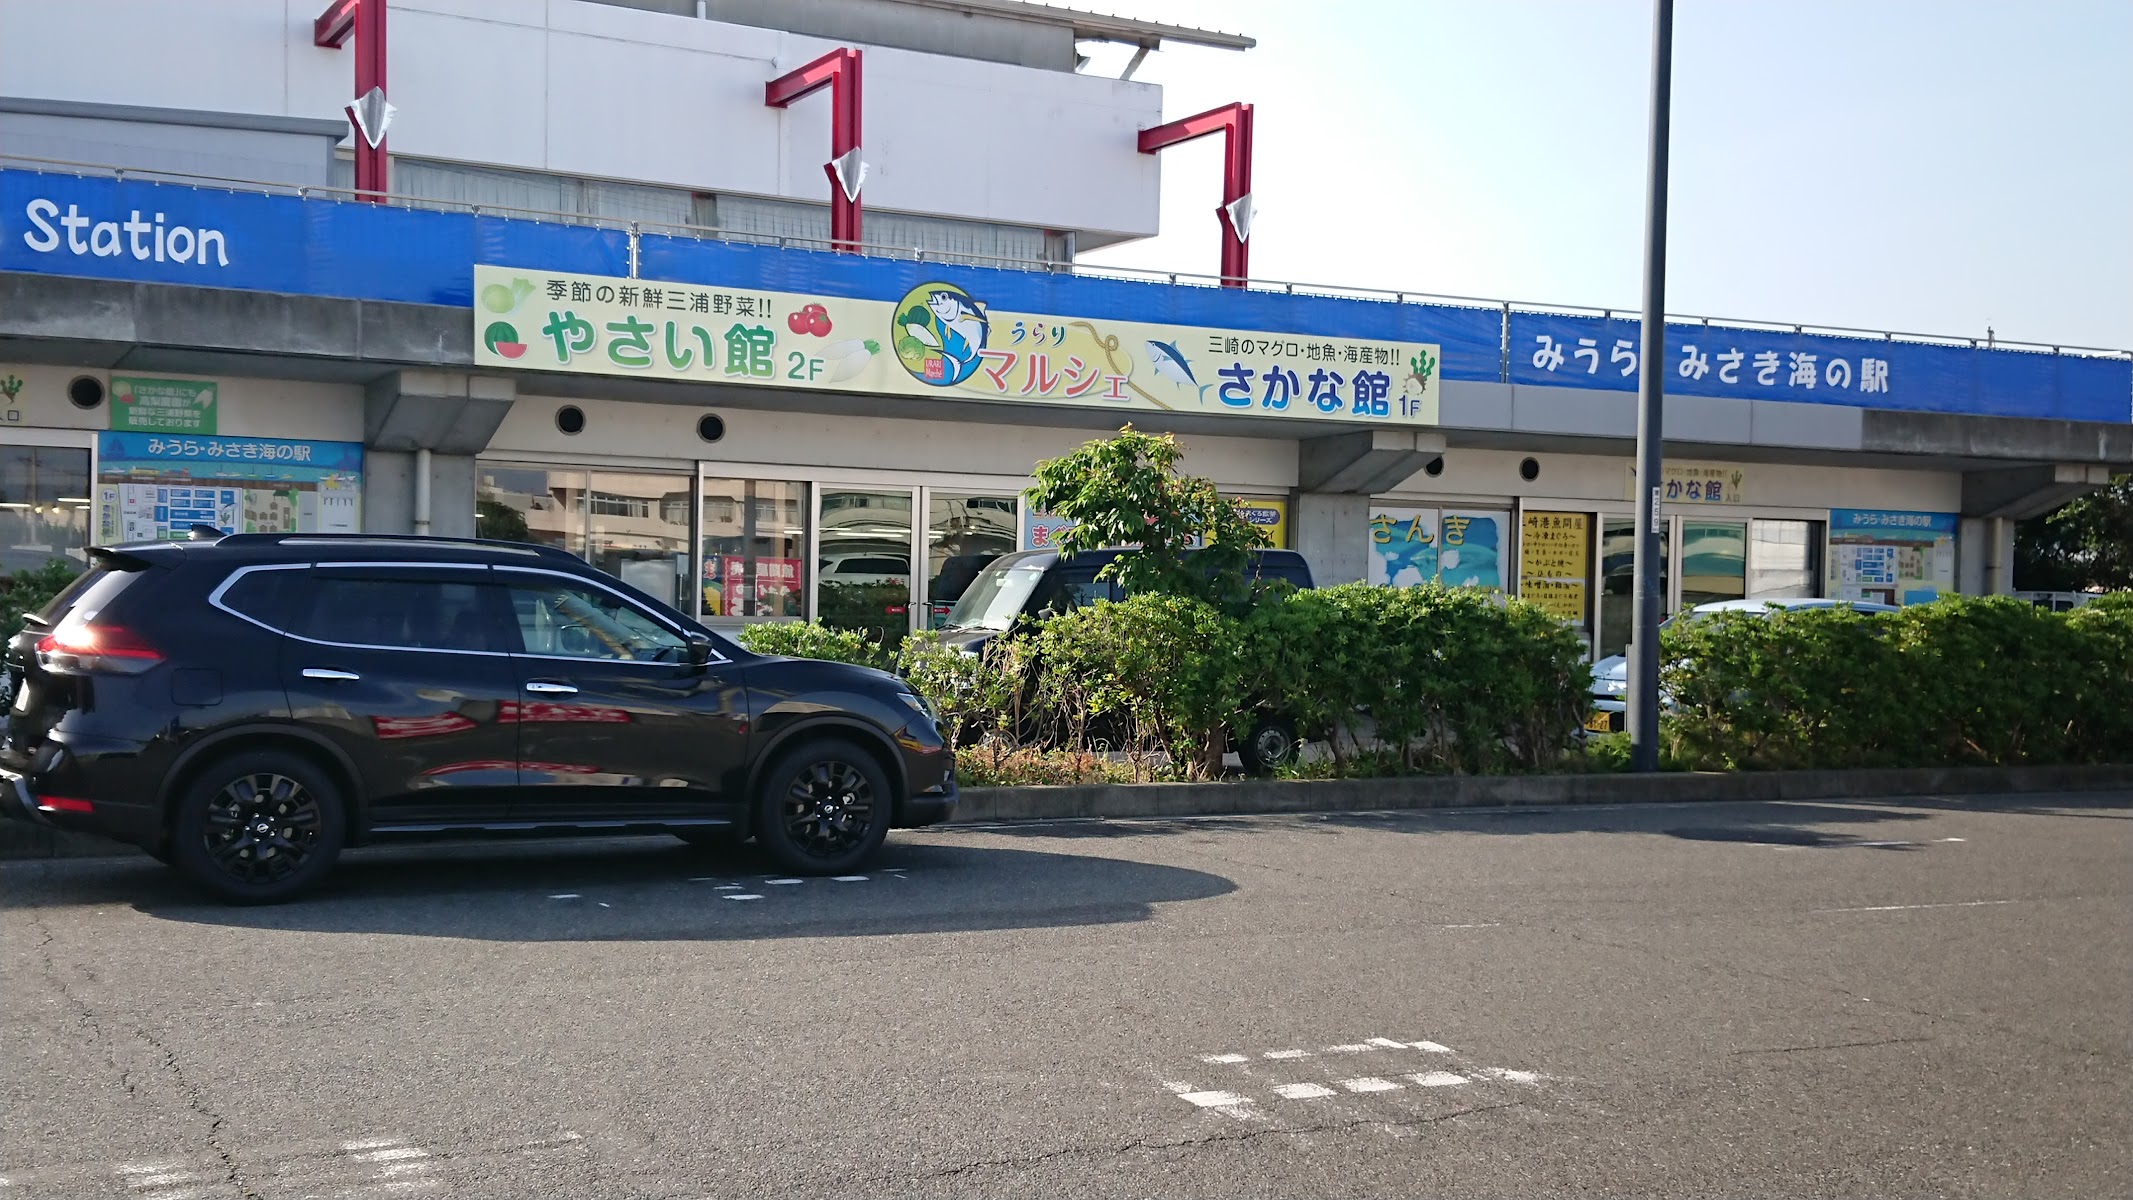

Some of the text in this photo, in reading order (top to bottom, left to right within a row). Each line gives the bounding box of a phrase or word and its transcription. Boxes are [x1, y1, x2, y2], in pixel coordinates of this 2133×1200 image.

[23, 198, 230, 267] Station
[546, 279, 772, 319] 季節の新鮮三浦野菜!!
[543, 310, 825, 381] やさい館 2F
[1010, 320, 1066, 348] うらり
[978, 349, 1131, 400] マルシェ
[1532, 334, 1889, 393] みうら みさき海の駅
[1217, 362, 1422, 417] さかな館 1F
[148, 438, 311, 461] みうら・みさき海の駅
[1660, 479, 1722, 501] かな館
